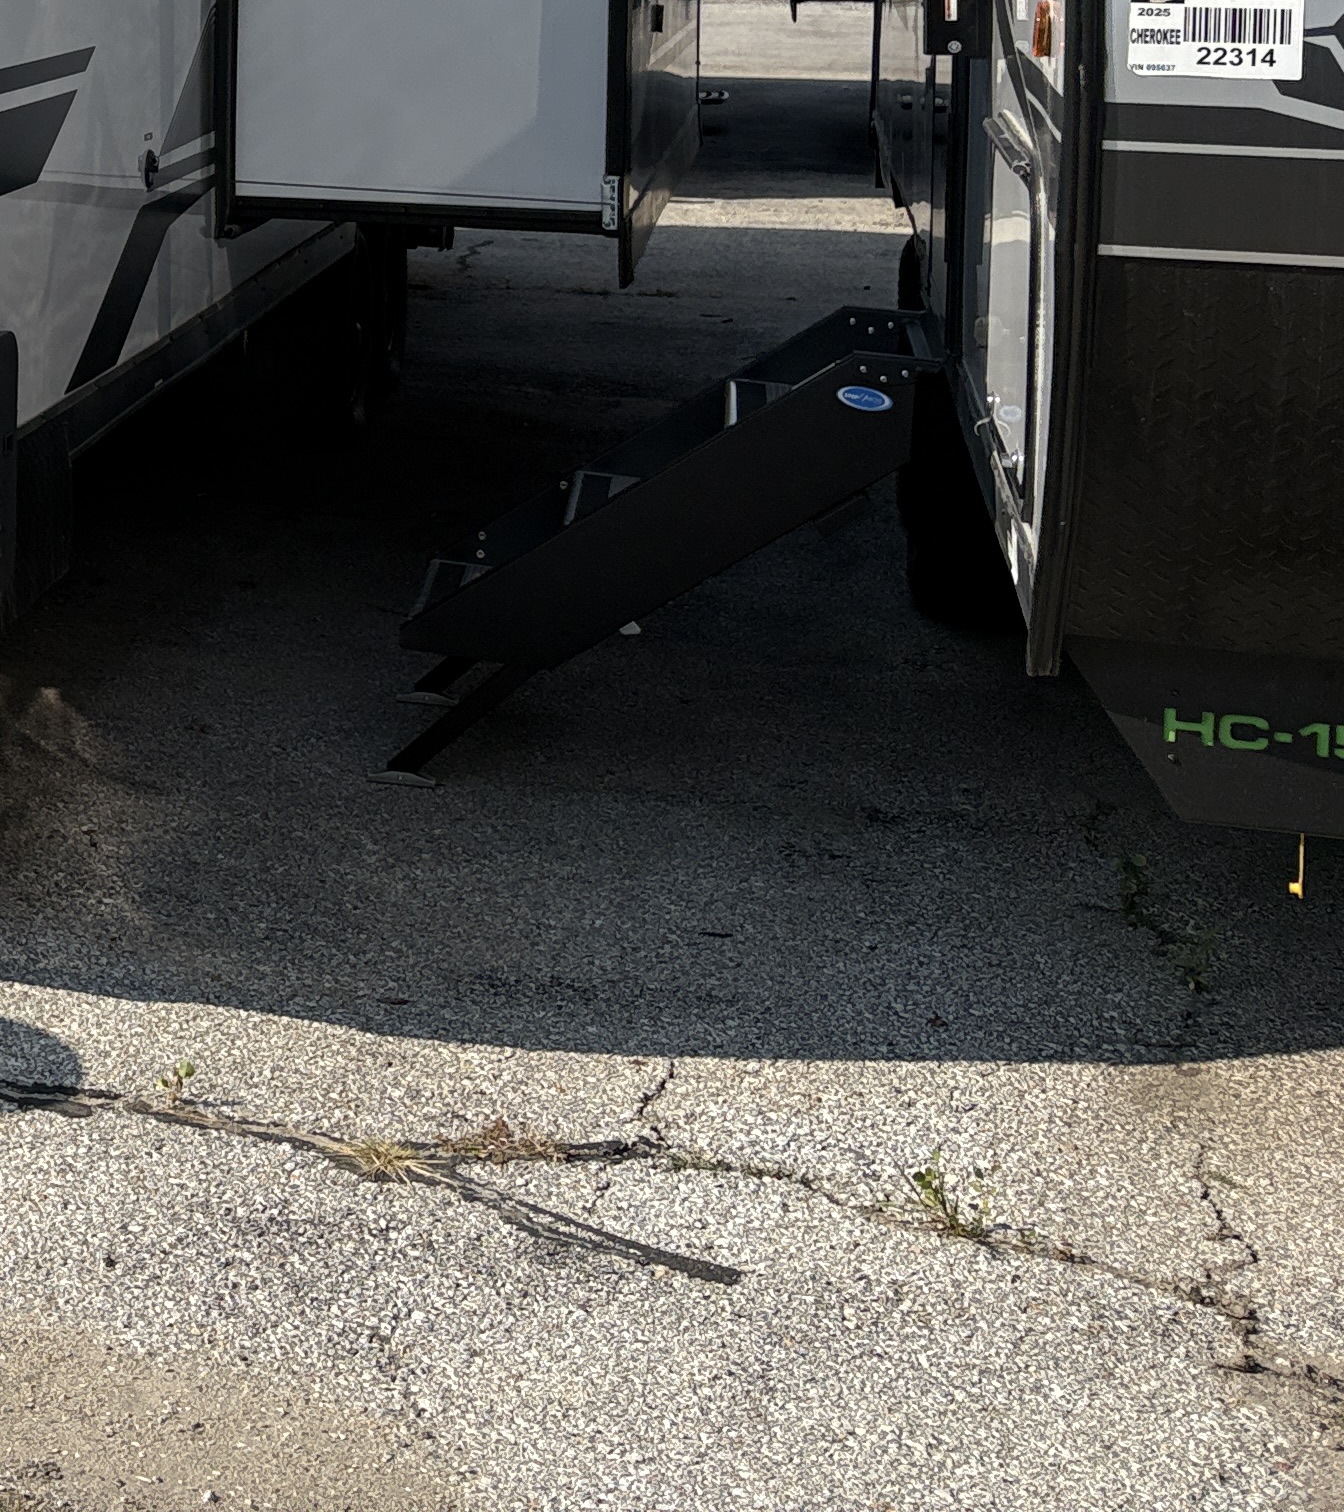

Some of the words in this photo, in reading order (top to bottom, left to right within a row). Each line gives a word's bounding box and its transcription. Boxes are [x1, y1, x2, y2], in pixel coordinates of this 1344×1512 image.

[1137, 7, 1171, 17] 2025
[1129, 27, 1181, 45] CHEROKEE
[1196, 46, 1277, 67] 22314
